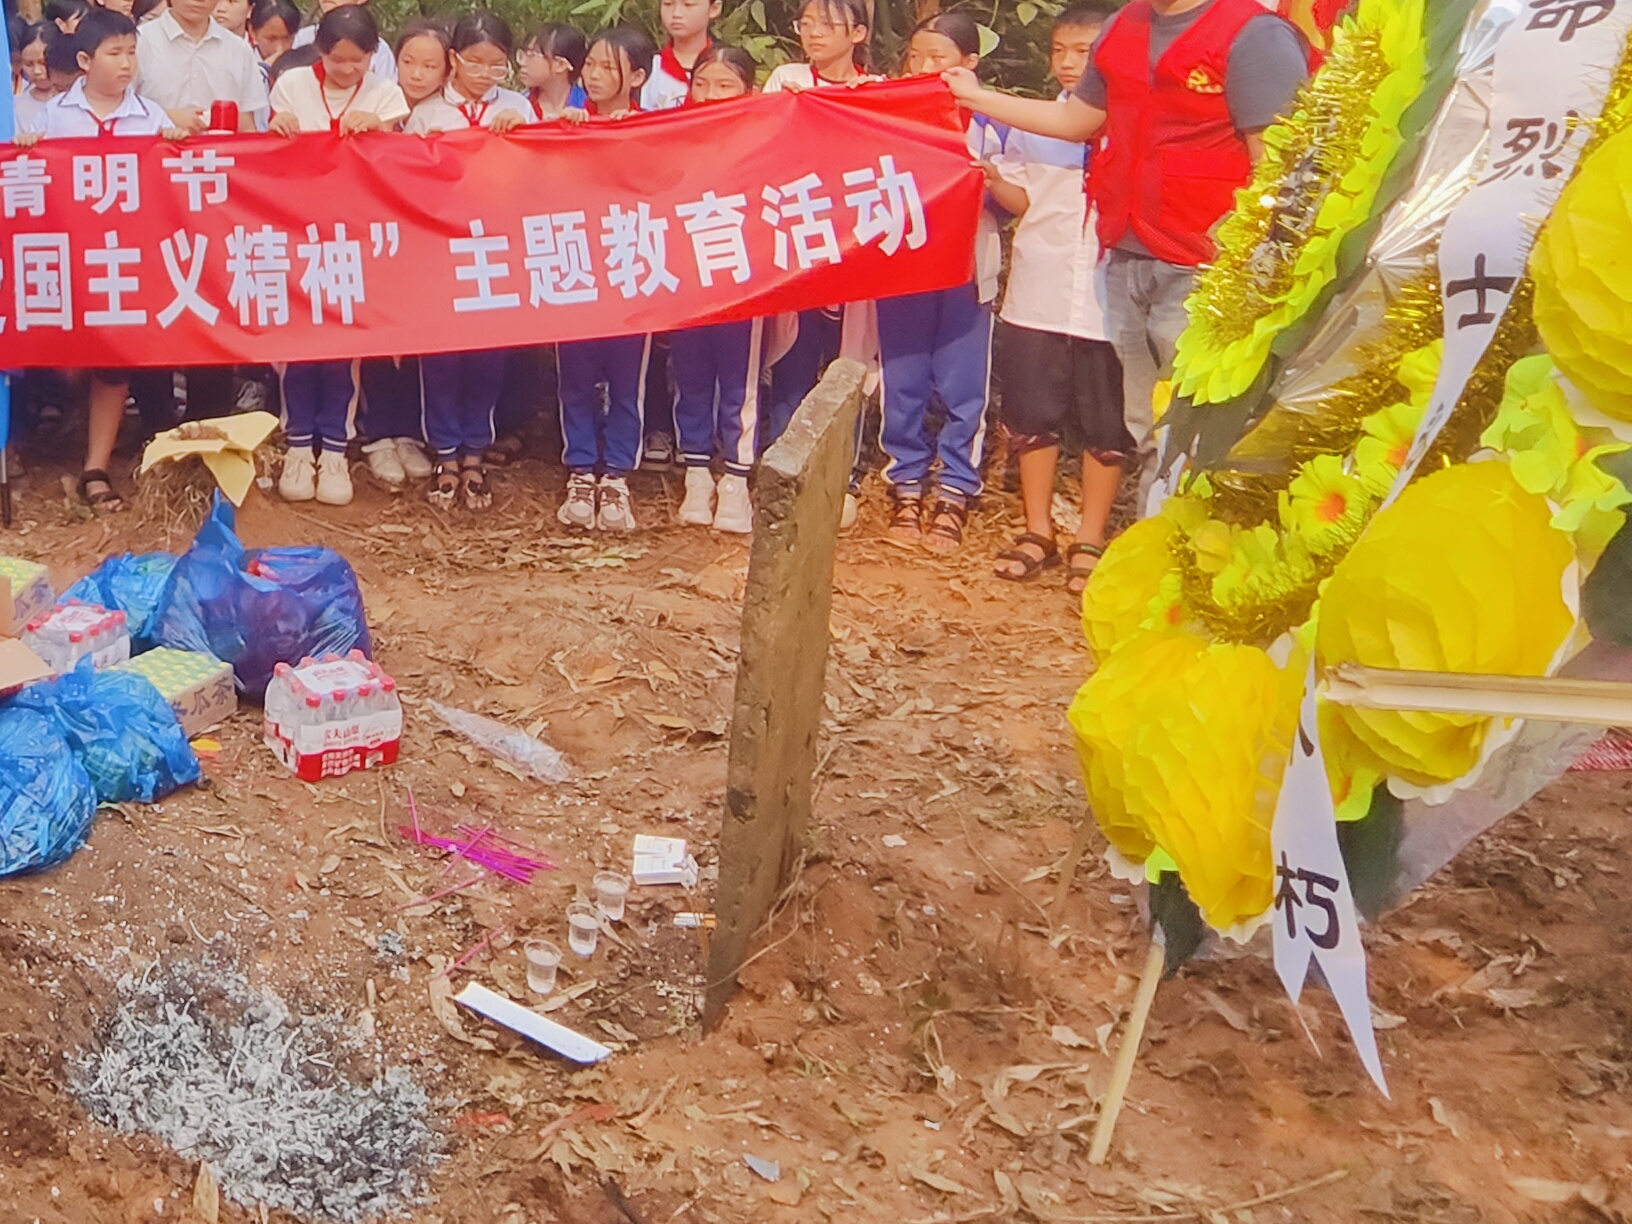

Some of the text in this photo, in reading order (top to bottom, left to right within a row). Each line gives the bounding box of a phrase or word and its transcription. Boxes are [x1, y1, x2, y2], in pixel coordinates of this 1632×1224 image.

[448, 154, 928, 314] 主题教育活动
[1274, 851, 1340, 950] 朽
